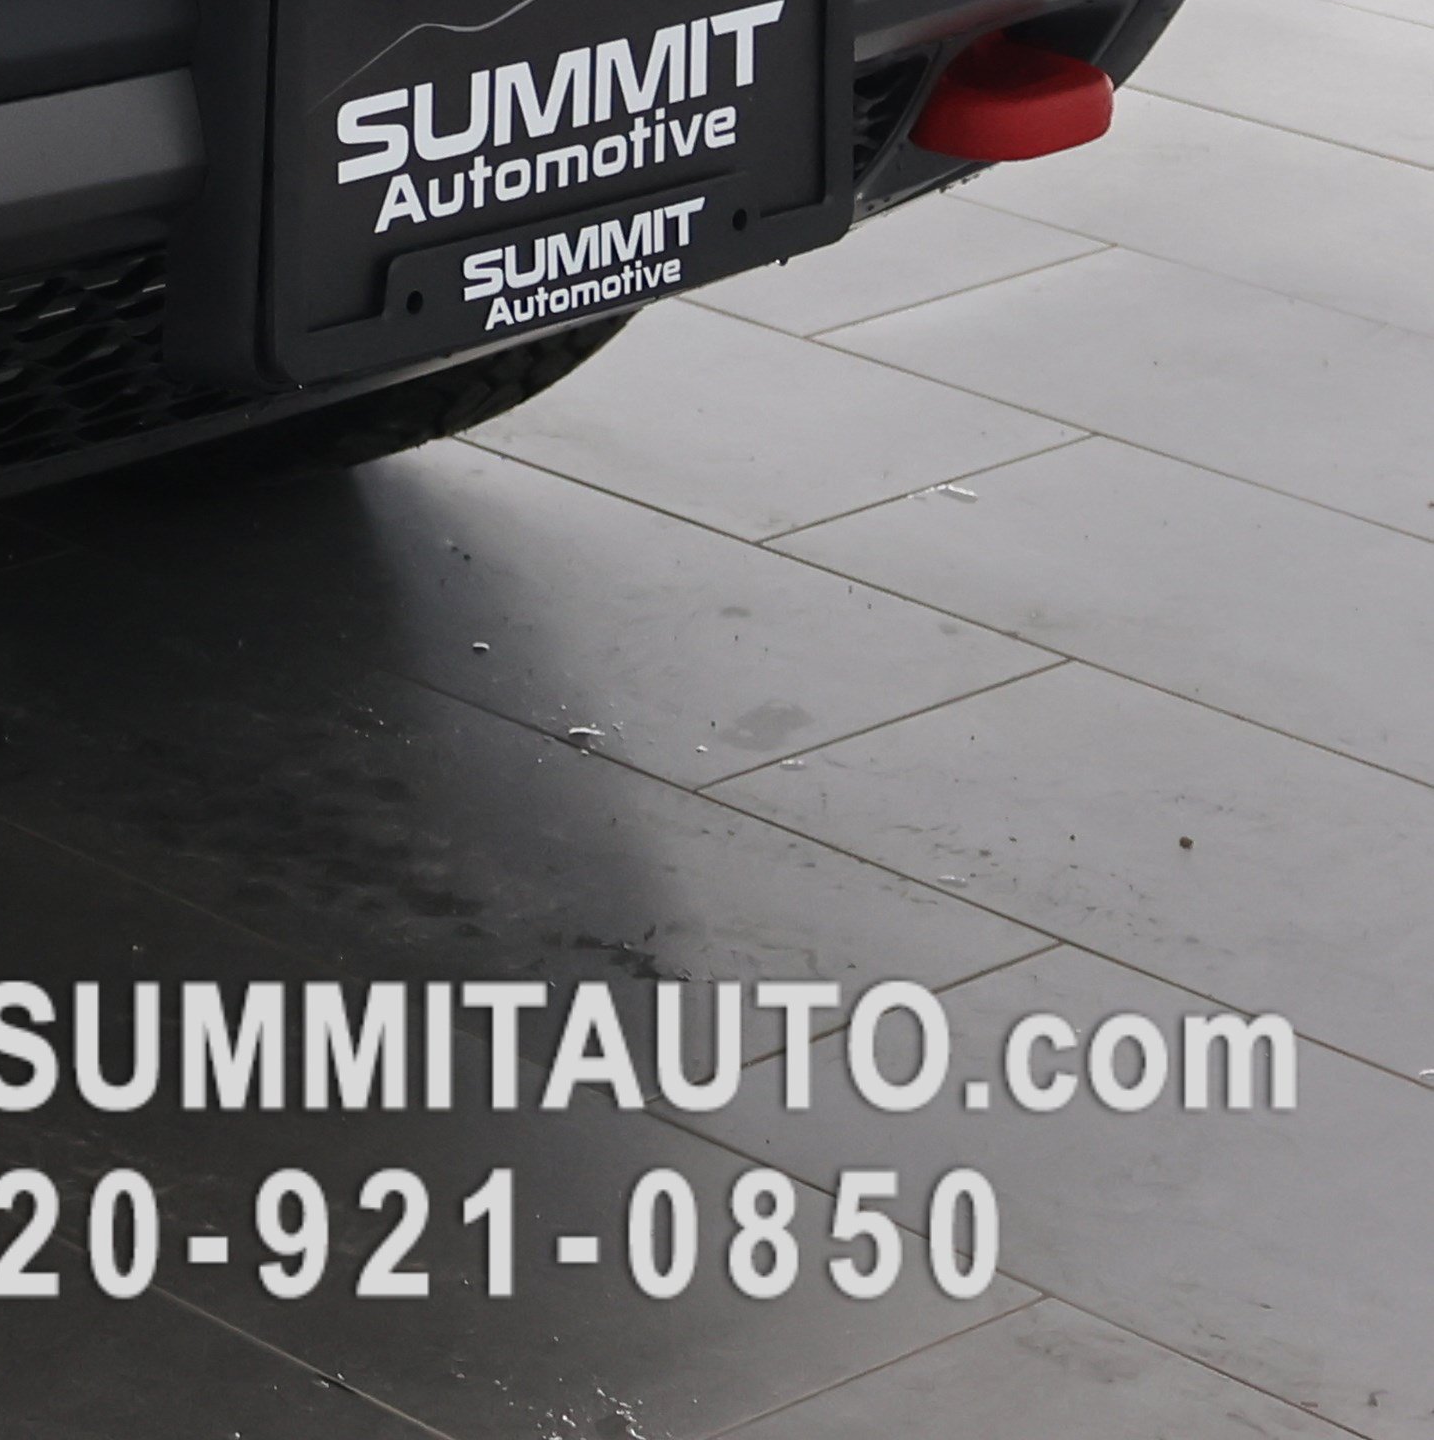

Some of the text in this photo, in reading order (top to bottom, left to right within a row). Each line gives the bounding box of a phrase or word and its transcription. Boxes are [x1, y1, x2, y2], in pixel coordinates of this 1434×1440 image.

[337, 0, 785, 184] SUMMIT
[374, 105, 737, 234] Automotive
[463, 197, 705, 302] SUMMIT
[484, 256, 682, 331] Automotive
